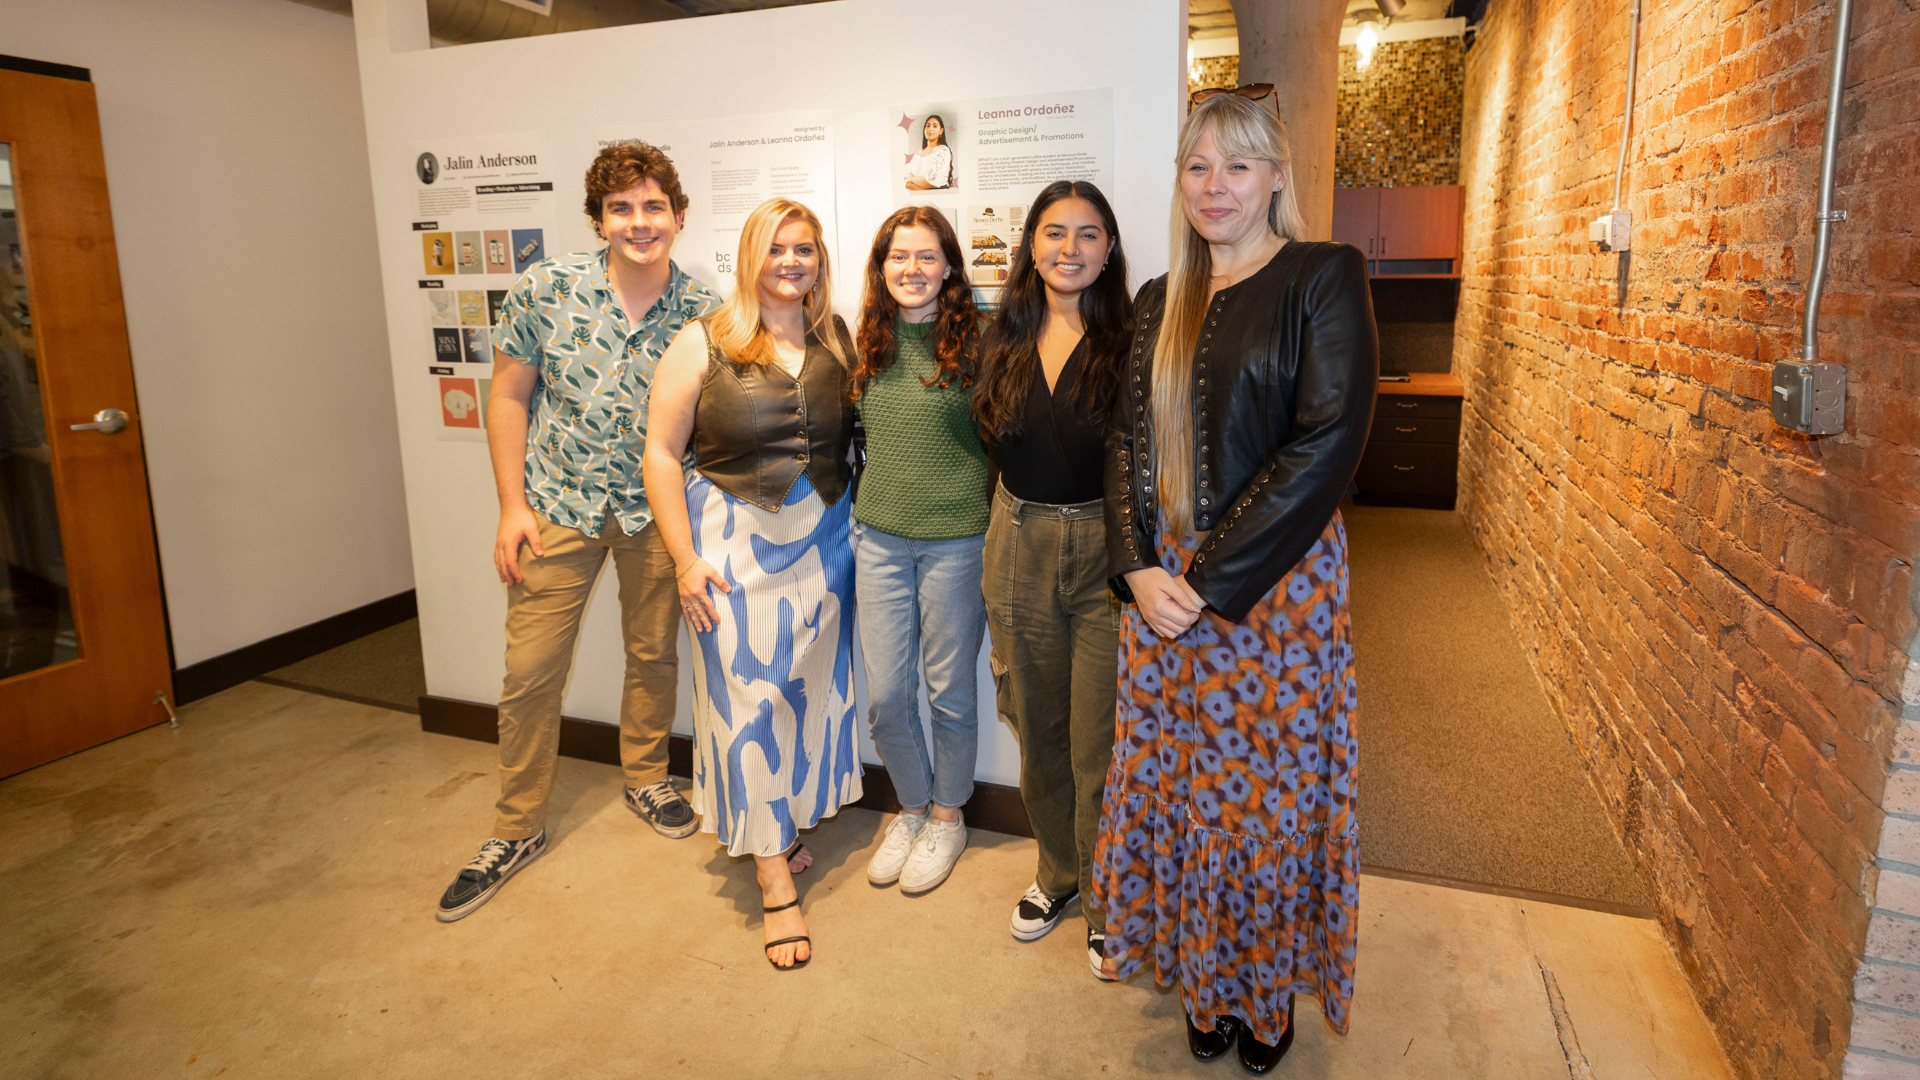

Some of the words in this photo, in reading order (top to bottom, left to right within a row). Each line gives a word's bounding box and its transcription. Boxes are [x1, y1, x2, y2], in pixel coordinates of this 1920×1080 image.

[978, 109, 1021, 120] Leanna
[1023, 103, 1075, 116] Ordoñez
[978, 127, 1007, 137] Graphic
[1008, 124, 1037, 135] Design/
[598, 138, 617, 147] Visual
[709, 140, 726, 148] Jalin
[727, 138, 760, 147] Anderson
[767, 136, 793, 144] Leanna
[793, 134, 826, 142] Ordoñez
[978, 135, 1032, 145] Advertisement
[1040, 132, 1085, 142] Promotions
[443, 155, 474, 171] Jalin
[476, 152, 538, 169] Anderson
[989, 216, 1004, 224] Derby
[715, 250, 731, 262] bc
[717, 261, 732, 273] ds
